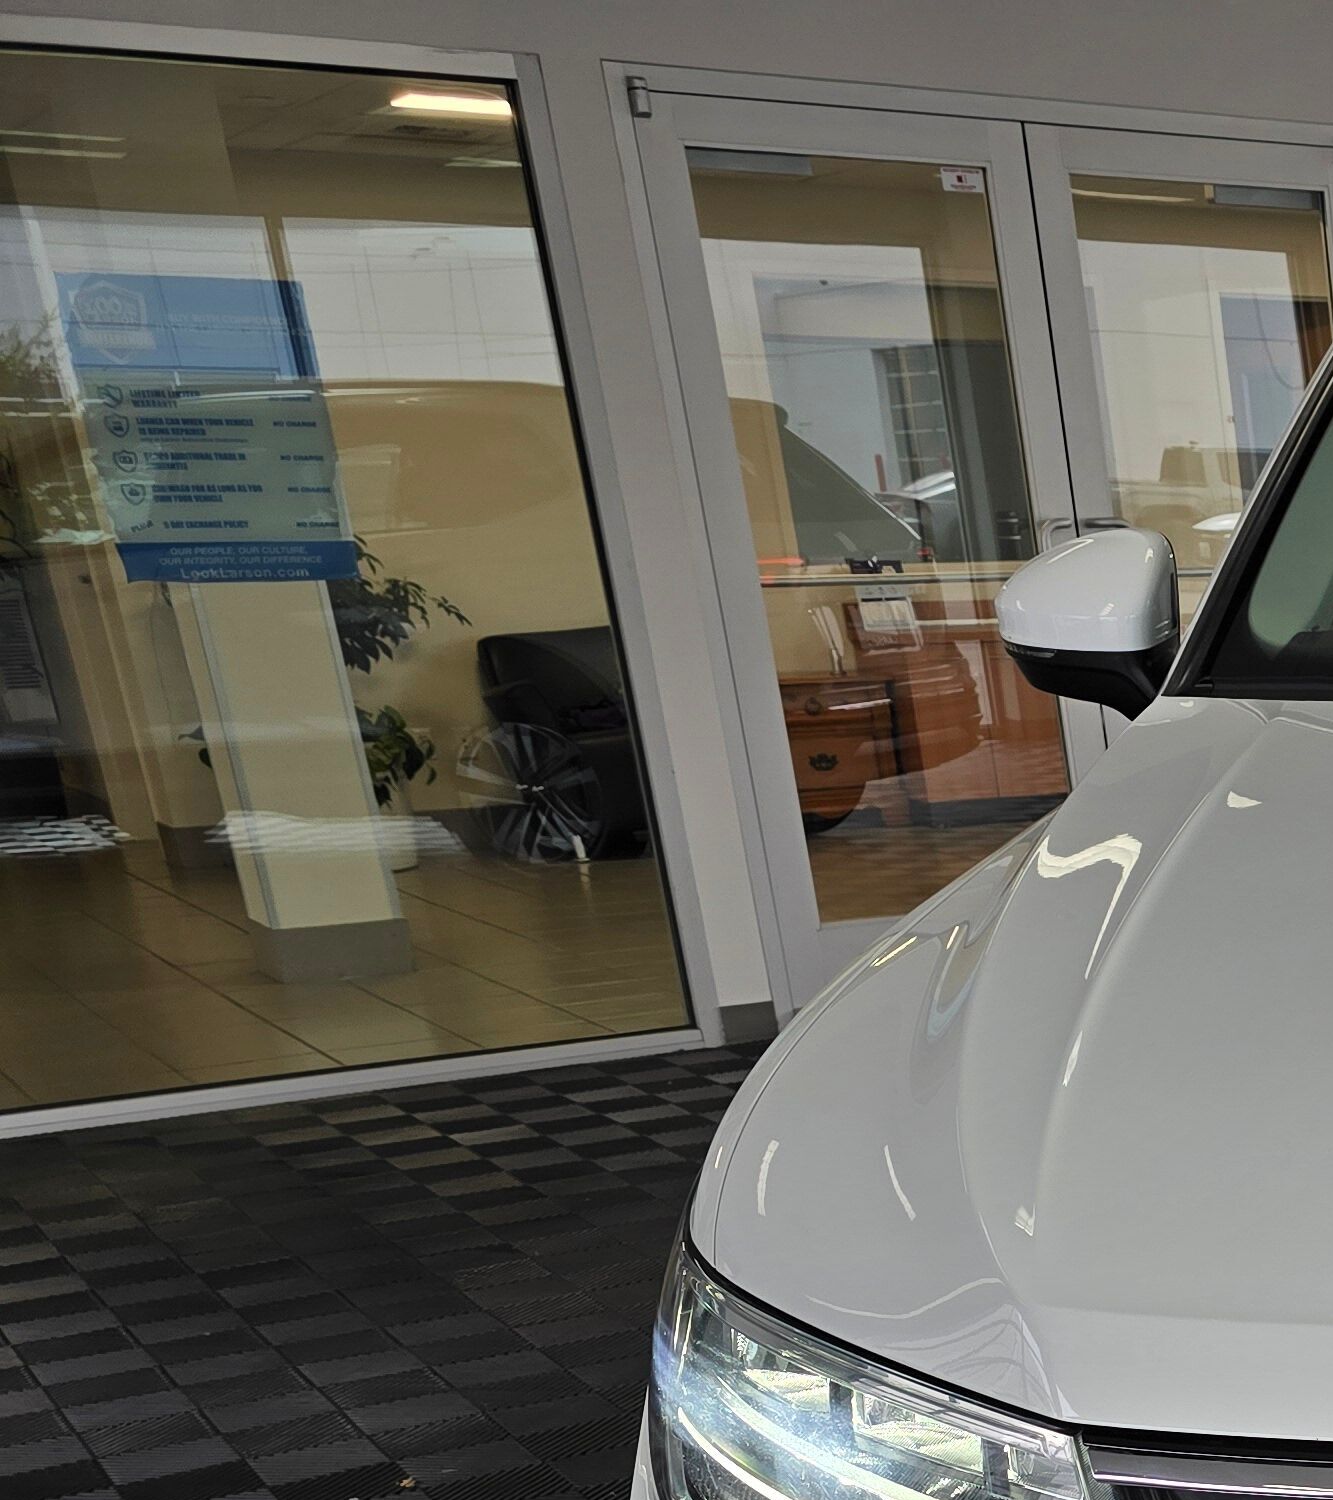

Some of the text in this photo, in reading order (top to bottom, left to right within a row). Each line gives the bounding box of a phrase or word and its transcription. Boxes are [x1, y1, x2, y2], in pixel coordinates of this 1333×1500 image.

[223, 520, 249, 528] POLICY
[170, 547, 192, 555] OUR
[238, 546, 260, 554] OUR
[159, 557, 183, 565] OUR
[239, 556, 261, 564] OUR
[263, 555, 322, 564] DIFFERENCE
[180, 568, 310, 579] LookLarson.com
